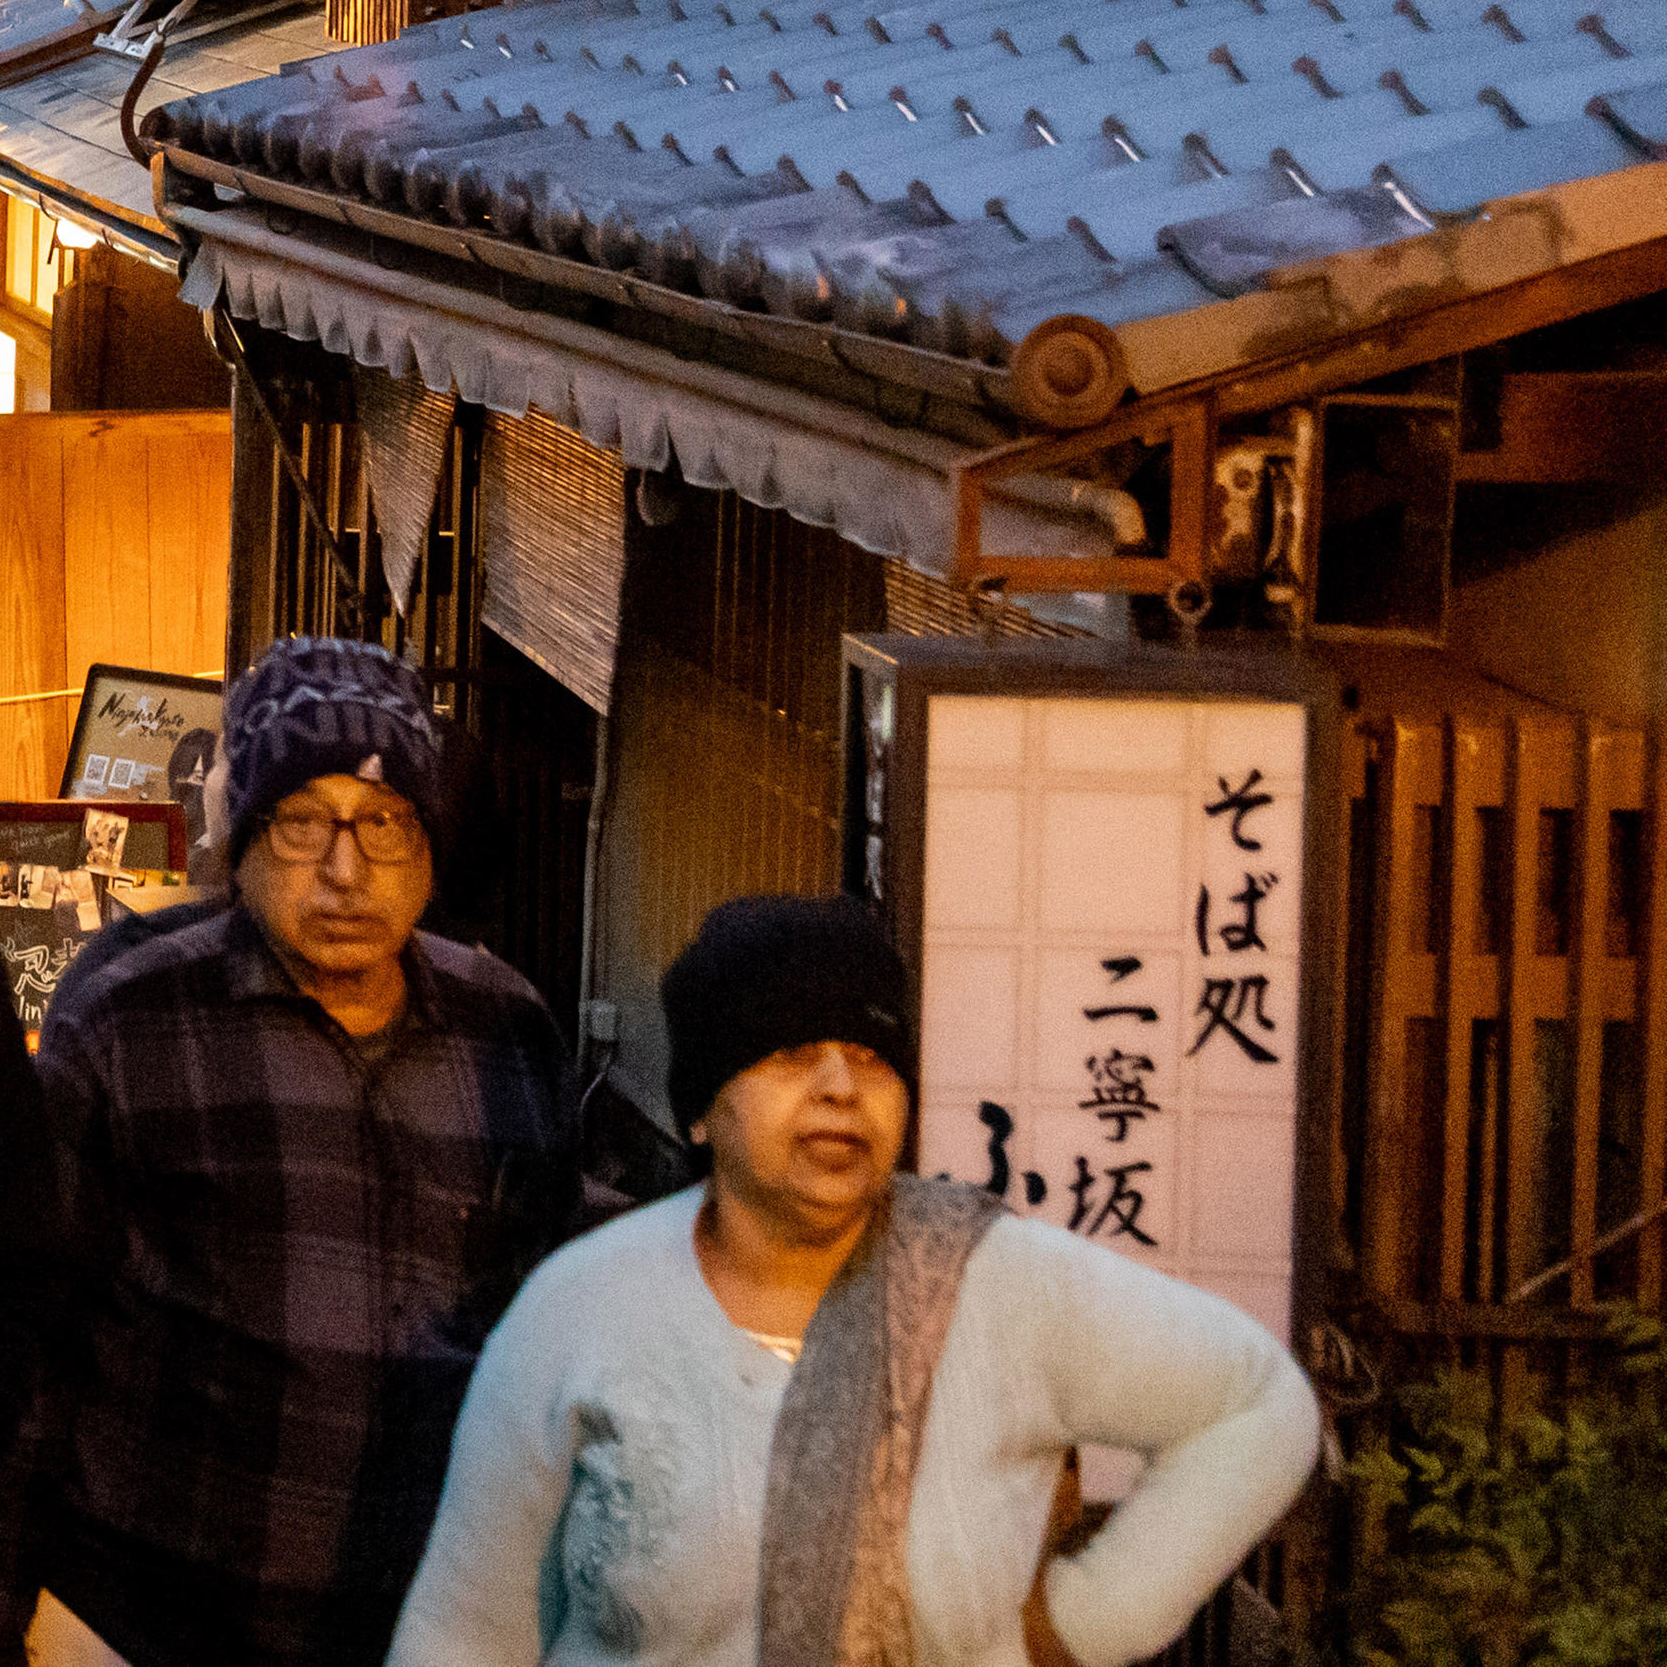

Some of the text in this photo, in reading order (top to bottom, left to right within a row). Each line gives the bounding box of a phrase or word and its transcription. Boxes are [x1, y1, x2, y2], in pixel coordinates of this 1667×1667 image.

[1187, 769, 1279, 1065] そば処
[1067, 955, 1160, 1247] 二寧坂
